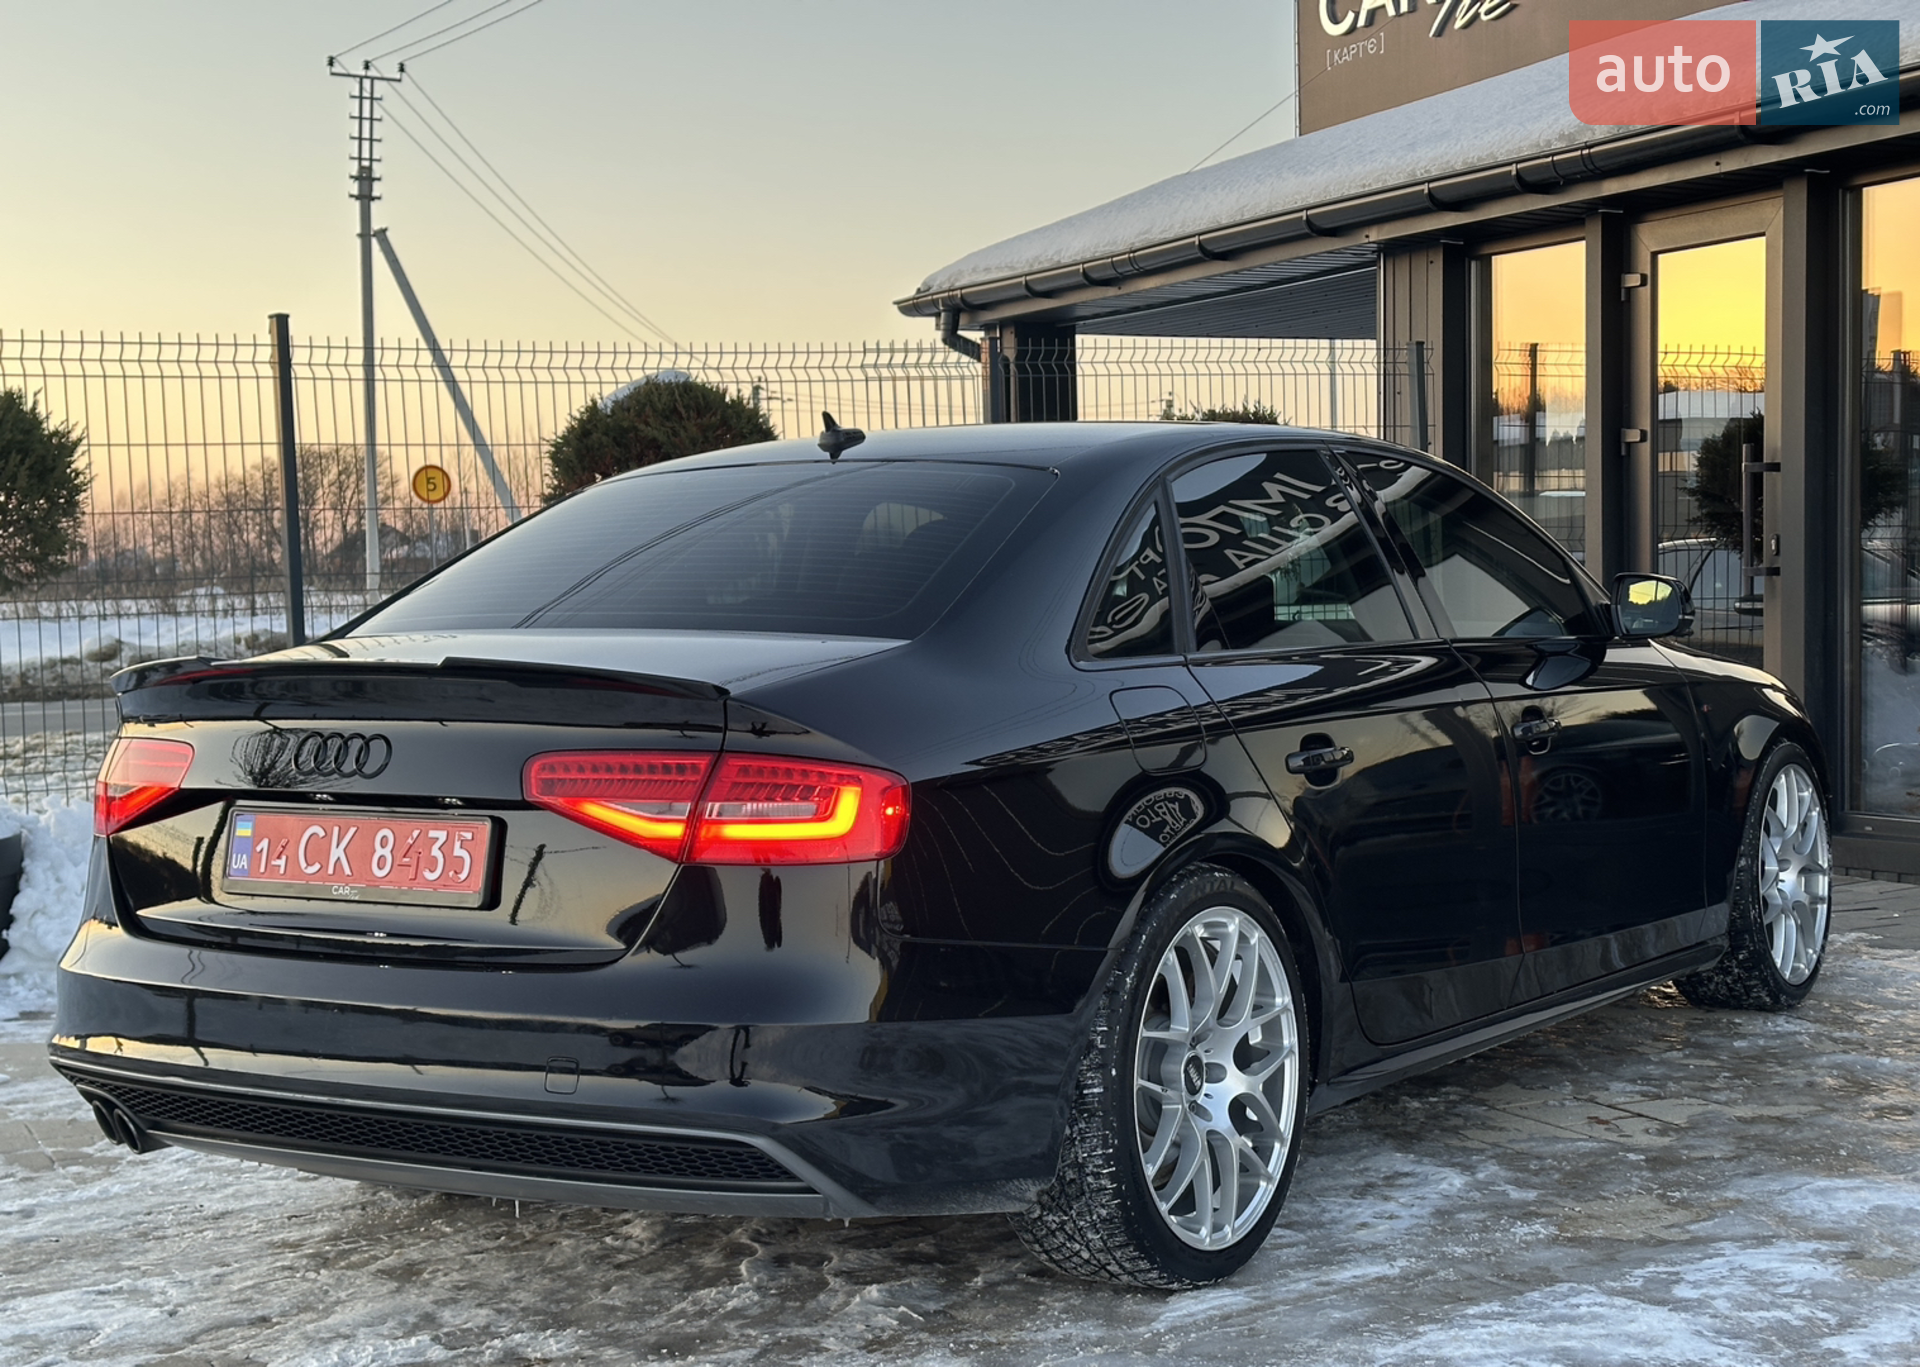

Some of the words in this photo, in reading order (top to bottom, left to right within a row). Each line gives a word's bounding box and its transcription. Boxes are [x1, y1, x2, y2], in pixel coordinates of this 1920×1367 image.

[427, 476, 437, 492] 5
[232, 853, 248, 870] UA
[255, 839, 289, 875] 14
[298, 825, 358, 877] CK
[371, 828, 474, 883] 8435
[331, 885, 351, 896] CAR
